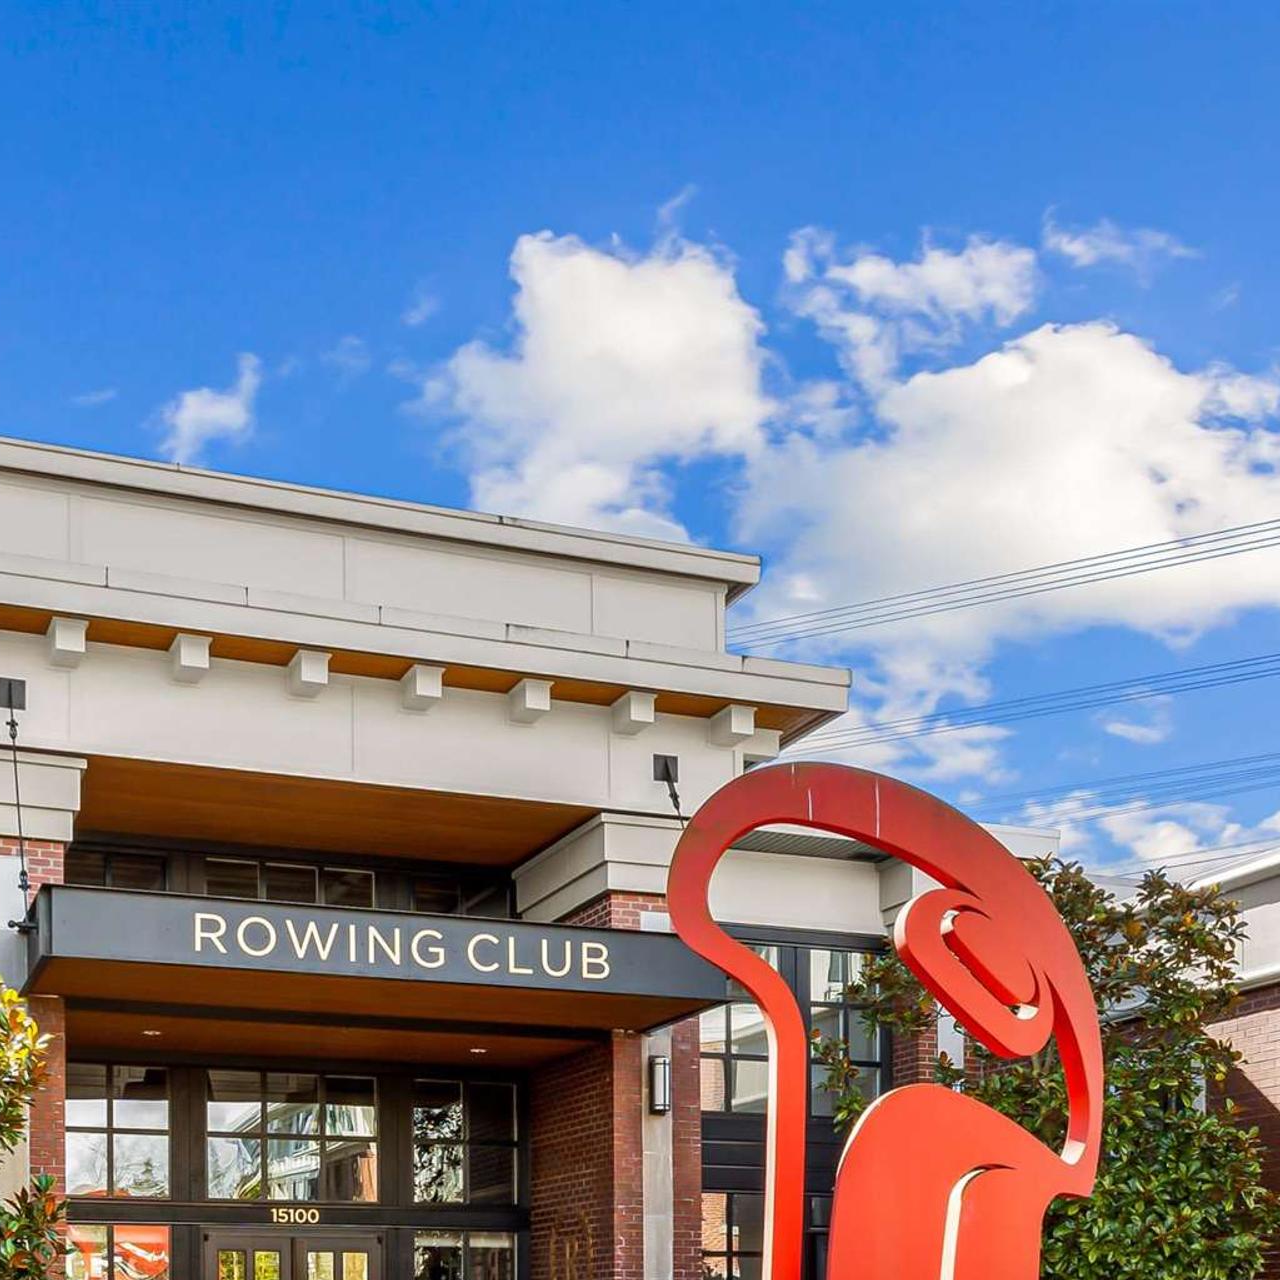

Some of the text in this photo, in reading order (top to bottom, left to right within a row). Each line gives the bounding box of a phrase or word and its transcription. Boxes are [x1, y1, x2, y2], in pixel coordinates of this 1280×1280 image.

[193, 912, 611, 980] ROWING CLUB
[270, 1207, 320, 1224] 15100
